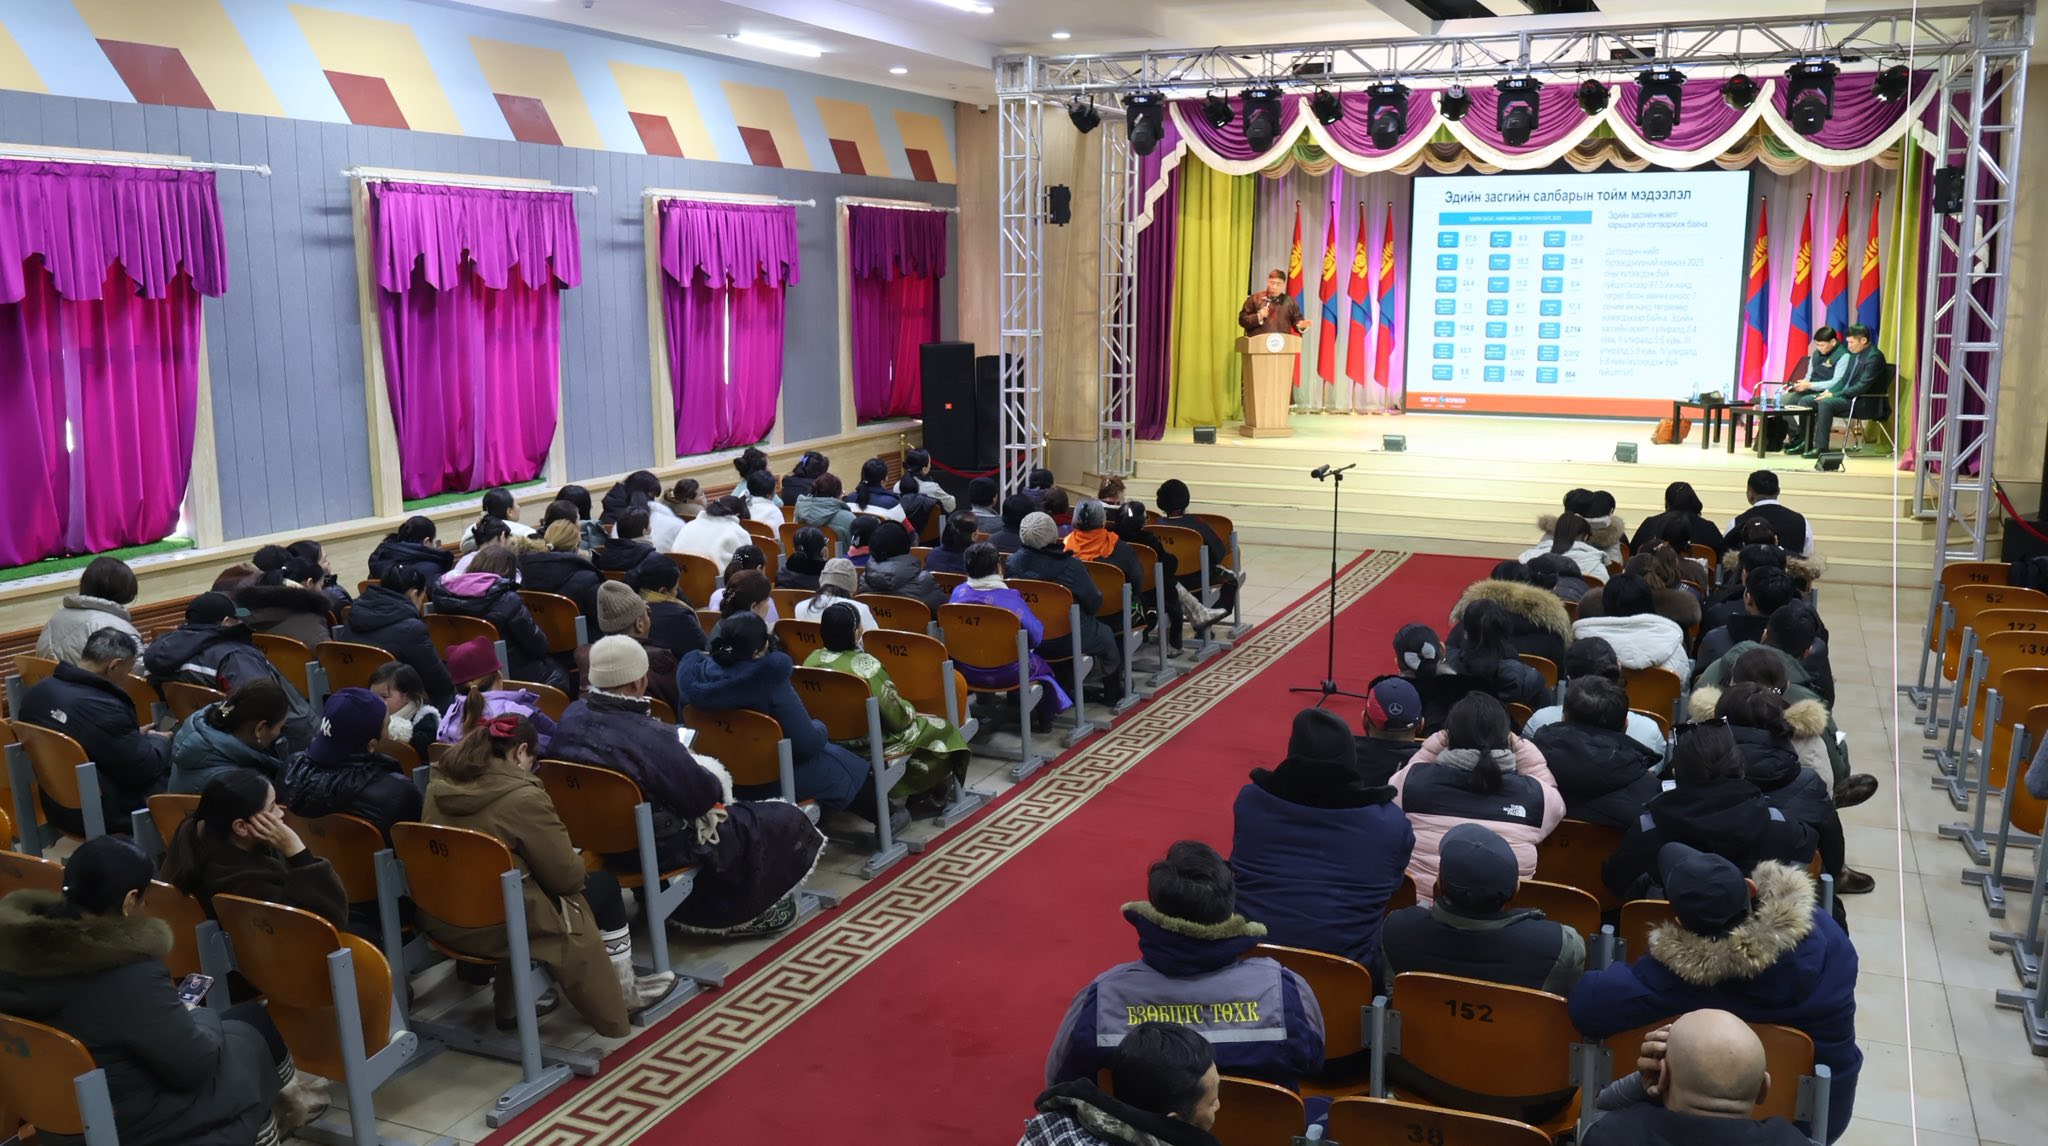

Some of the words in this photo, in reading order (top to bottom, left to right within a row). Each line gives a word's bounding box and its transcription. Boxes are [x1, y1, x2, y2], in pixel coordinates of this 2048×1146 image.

[1445, 190, 1481, 205] Эдийн
[1484, 190, 1530, 203] засгийн
[1533, 189, 1593, 204] салбарын
[1598, 188, 1627, 202] тойм
[1631, 189, 1692, 202] мэдээлэл
[796, 631, 818, 644] 101
[886, 644, 909, 657] 102
[1127, 1003, 1204, 1026] БЗӨБЦТС
[1210, 1001, 1260, 1024] ТӨХК
[1445, 999, 1495, 1024] 152
[1407, 1123, 1445, 1146] 38
